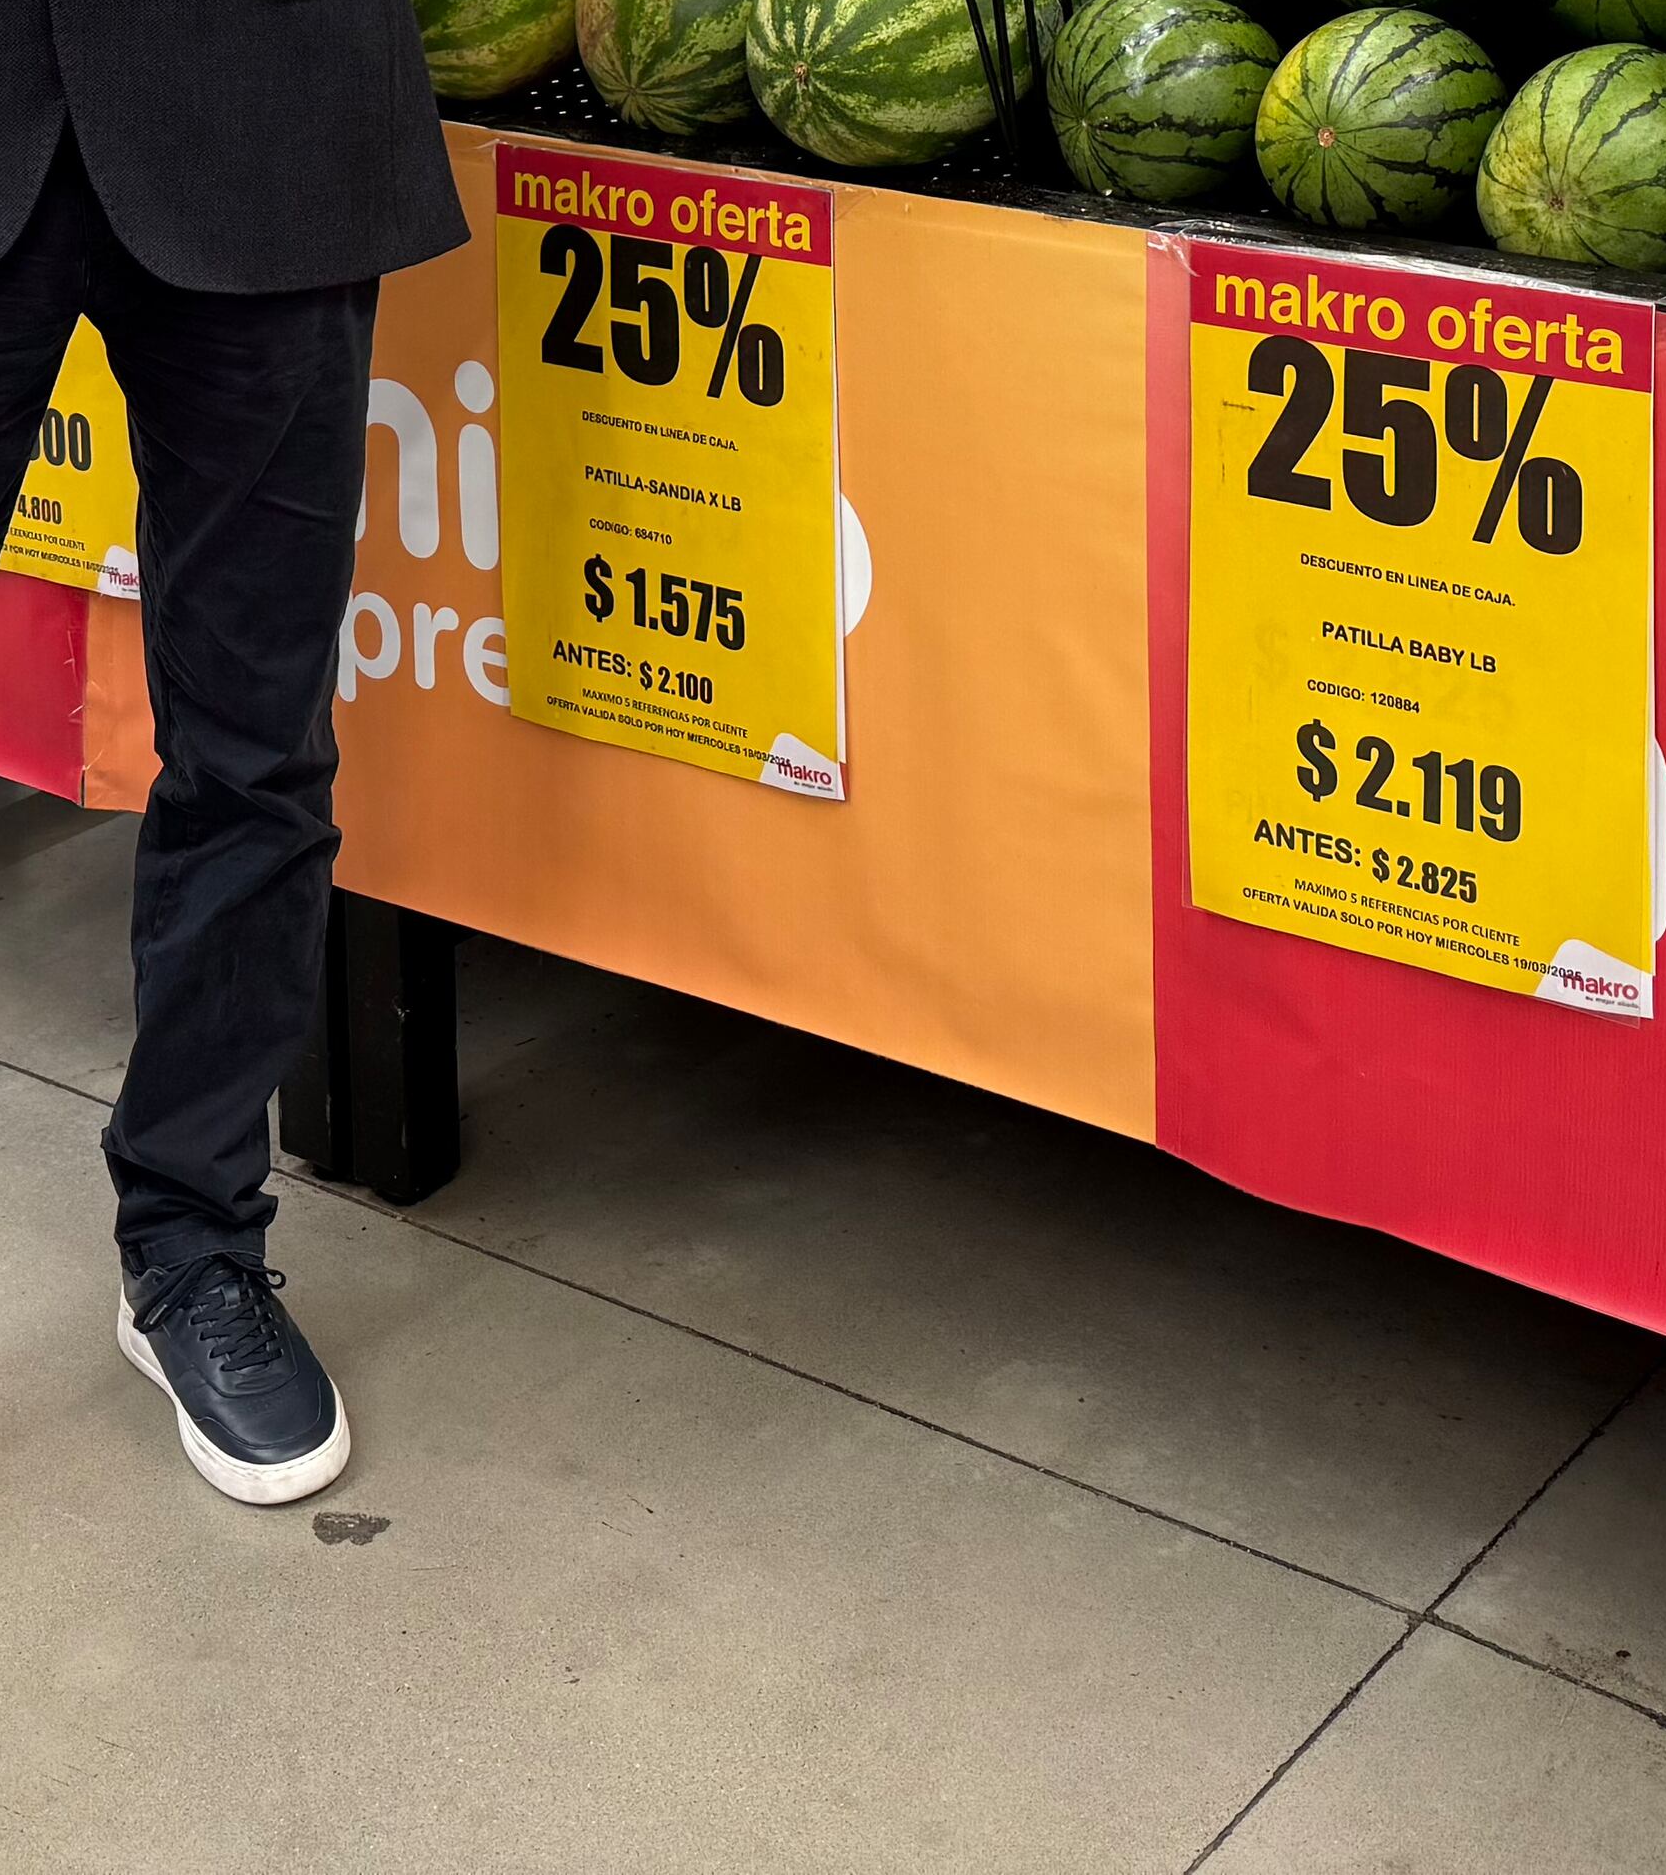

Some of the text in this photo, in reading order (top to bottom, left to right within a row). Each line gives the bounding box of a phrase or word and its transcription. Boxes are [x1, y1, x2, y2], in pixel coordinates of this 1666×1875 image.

[514, 171, 813, 252] makro oferta
[540, 223, 784, 407] 25%
[1215, 274, 1624, 375] makro oferta
[29, 408, 92, 471] 00
[582, 410, 642, 432] DESCUENTO
[644, 424, 658, 436] EN
[660, 426, 690, 442] LINEA
[693, 433, 707, 445] DE
[1247, 334, 1583, 555] 25%
[585, 465, 742, 512] PATILLA-SANDIA X LB
[589, 518, 632, 537] CODIGO:
[109, 571, 140, 586] mak
[584, 553, 746, 651] $ 1.575
[1300, 553, 1516, 607] DESCUENTO EN LINEA DE CAJA.
[337, 590, 511, 707] pre
[552, 639, 713, 705] ANTES: $ 2.100
[1322, 621, 1496, 673] PATILLA BABY LB
[546, 695, 580, 713] OFERTA
[582, 705, 616, 722] VALIDA
[618, 713, 643, 728] SOLO
[645, 721, 664, 734] POR
[666, 727, 685, 739] HOY
[687, 732, 741, 755] MIERCOLES
[582, 687, 623, 707] MAXIMO
[632, 700, 690, 723] REFERENCIAS
[692, 715, 710, 728] POR
[713, 720, 748, 739] CLIENTE
[1307, 679, 1420, 714] CODIGO: 120884
[777, 761, 832, 786] makro
[1296, 718, 1522, 842] $ 2.119
[1254, 818, 1478, 904] ANTES: $ 2.825
[1242, 887, 1290, 909] OFERTA
[1293, 900, 1338, 921] VALIDA
[1340, 911, 1375, 930] SOLO
[1377, 921, 1403, 938] POR
[1406, 929, 1433, 945] HOY
[1435, 936, 1510, 966] MIERCOLES
[1294, 878, 1520, 947] MAXIMO 5 REFERENCIAS POR CLIENTE
[1563, 975, 1639, 1001] makro
